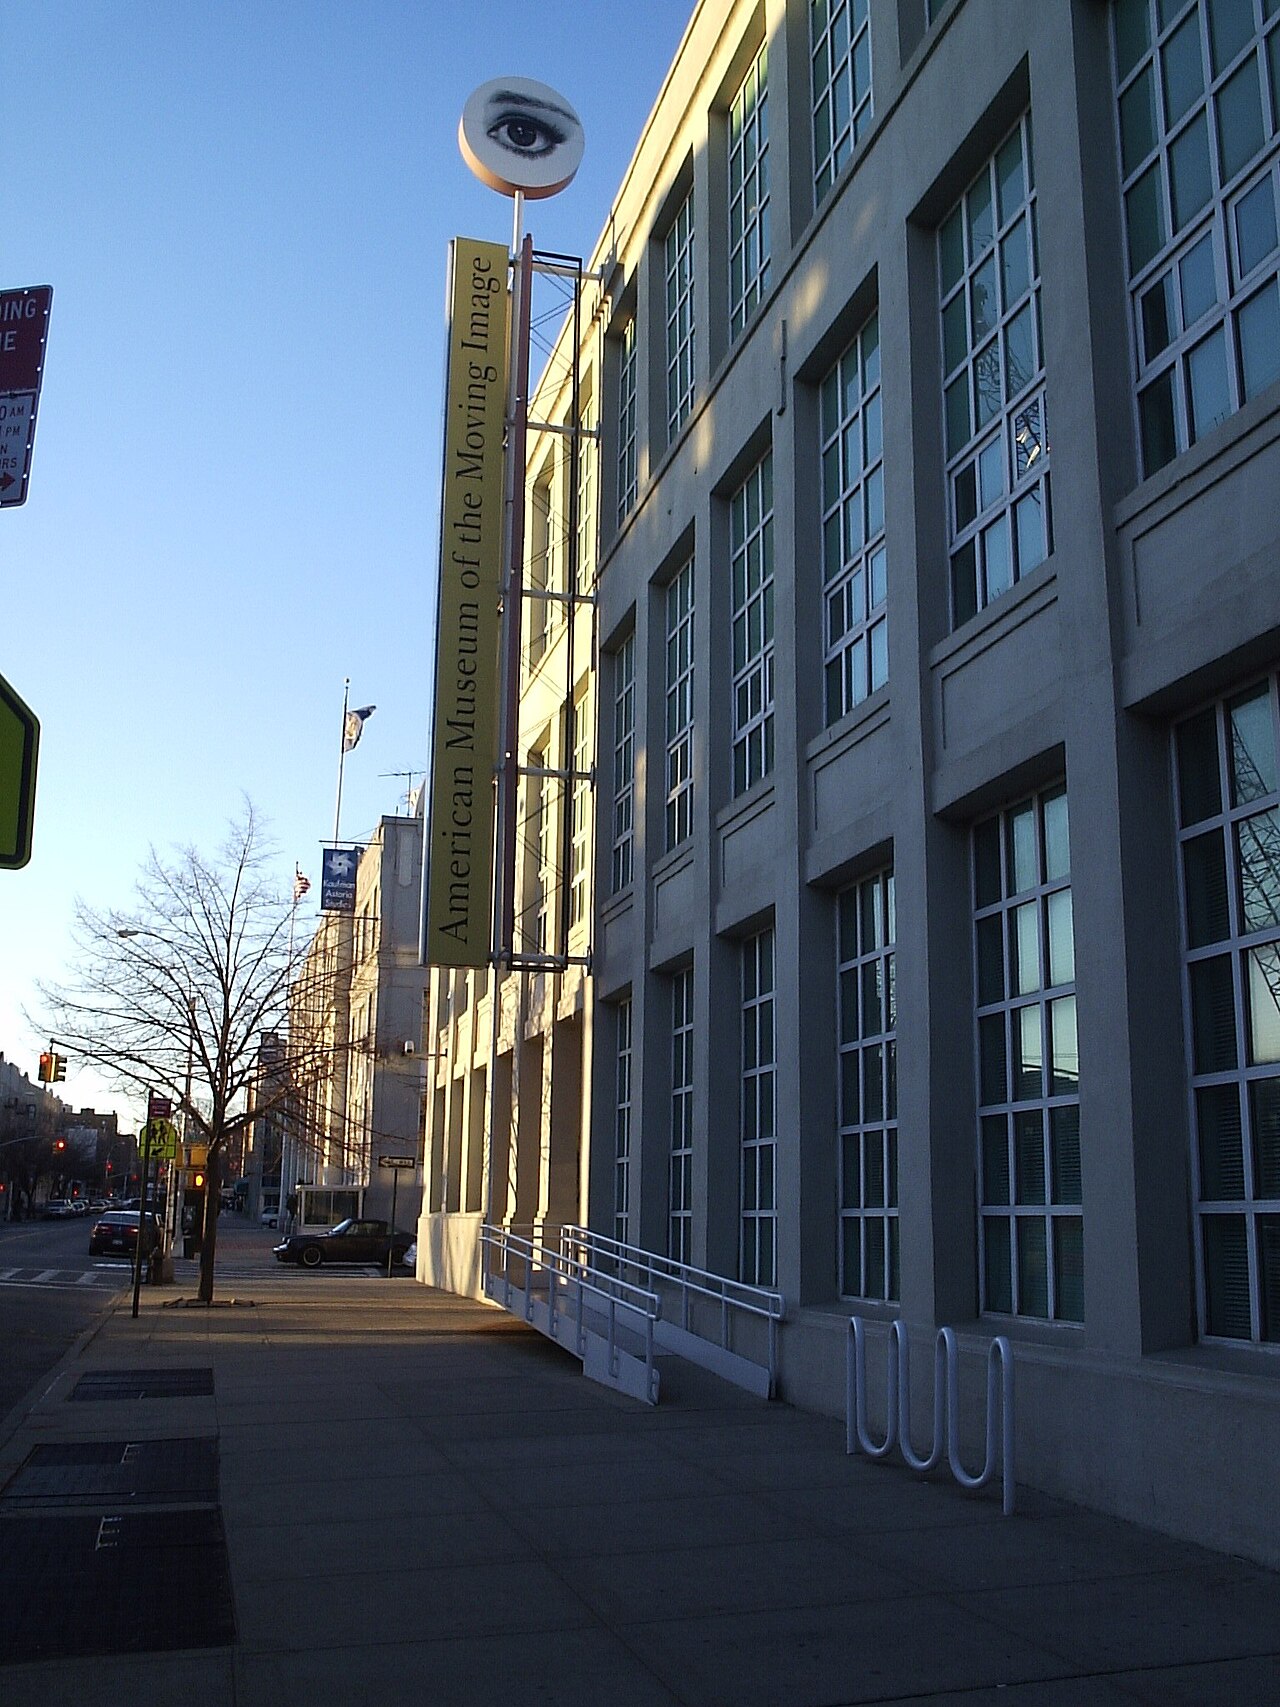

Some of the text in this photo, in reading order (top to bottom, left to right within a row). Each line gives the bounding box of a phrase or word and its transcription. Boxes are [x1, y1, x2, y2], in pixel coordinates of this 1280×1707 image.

[0, 298, 37, 321] ING
[439, 256, 500, 945] American Museum of the Moving Image
